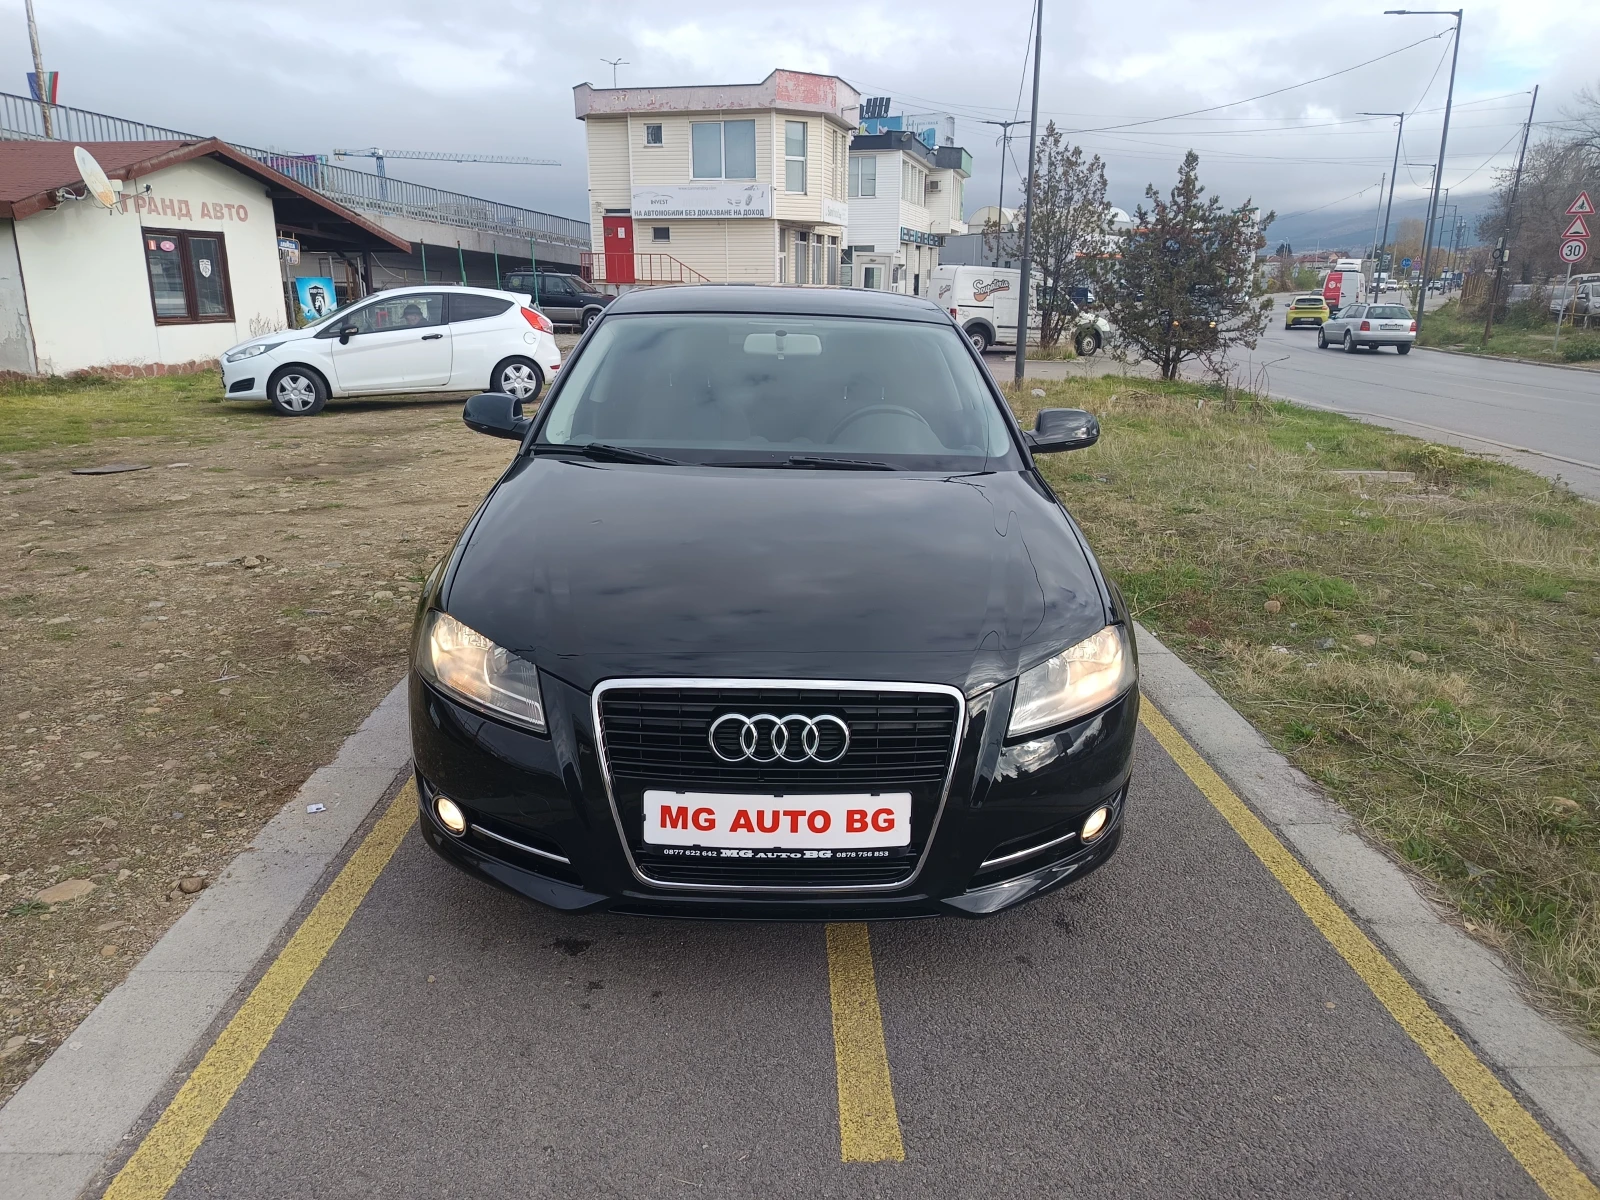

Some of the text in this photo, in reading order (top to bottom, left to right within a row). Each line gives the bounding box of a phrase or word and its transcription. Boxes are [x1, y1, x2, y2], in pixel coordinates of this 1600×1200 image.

[121, 194, 249, 222] ГРАНД АВТО
[634, 209, 765, 217] НА АВТОМОБИЛИ БЕЗ ДОКАЗВАНЕ НА ДОХОД
[1565, 244, 1581, 257] 30
[660, 805, 895, 834] MG AUTO BG
[720, 849, 755, 858] MG
[803, 850, 833, 858] BG
